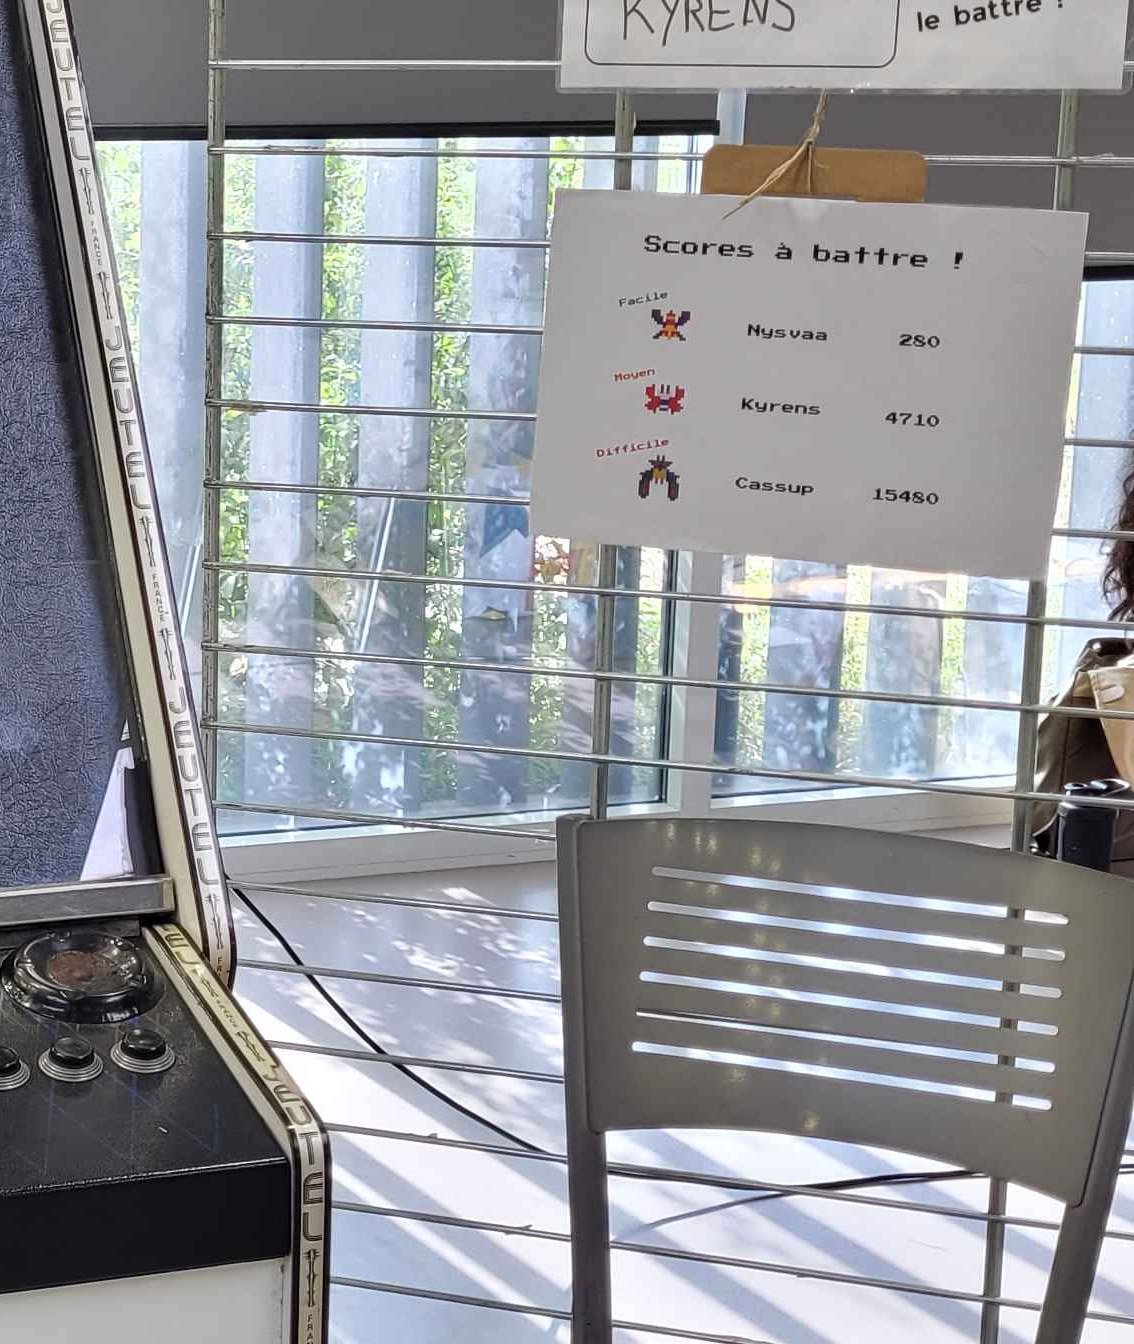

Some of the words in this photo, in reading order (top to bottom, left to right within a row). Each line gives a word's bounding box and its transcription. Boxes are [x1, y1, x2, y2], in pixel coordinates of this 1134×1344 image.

[915, 10, 941, 33] le
[89, 218, 103, 267] FRANCE
[644, 234, 755, 259] Scores
[774, 240, 793, 262] à
[813, 243, 929, 269] battre
[618, 291, 668, 307] Facile
[747, 323, 828, 343] Nysvaa
[898, 333, 940, 349] 280
[613, 367, 656, 383] Moyen
[105, 326, 152, 510] JEUTEL
[740, 397, 821, 417] Kyrens
[885, 410, 940, 428] 4710
[596, 438, 669, 458] Difficile
[735, 476, 814, 497] Cassup
[872, 487, 939, 506] 15480
[151, 572, 167, 623] FRANCE
[167, 686, 220, 885] JEUTEL
